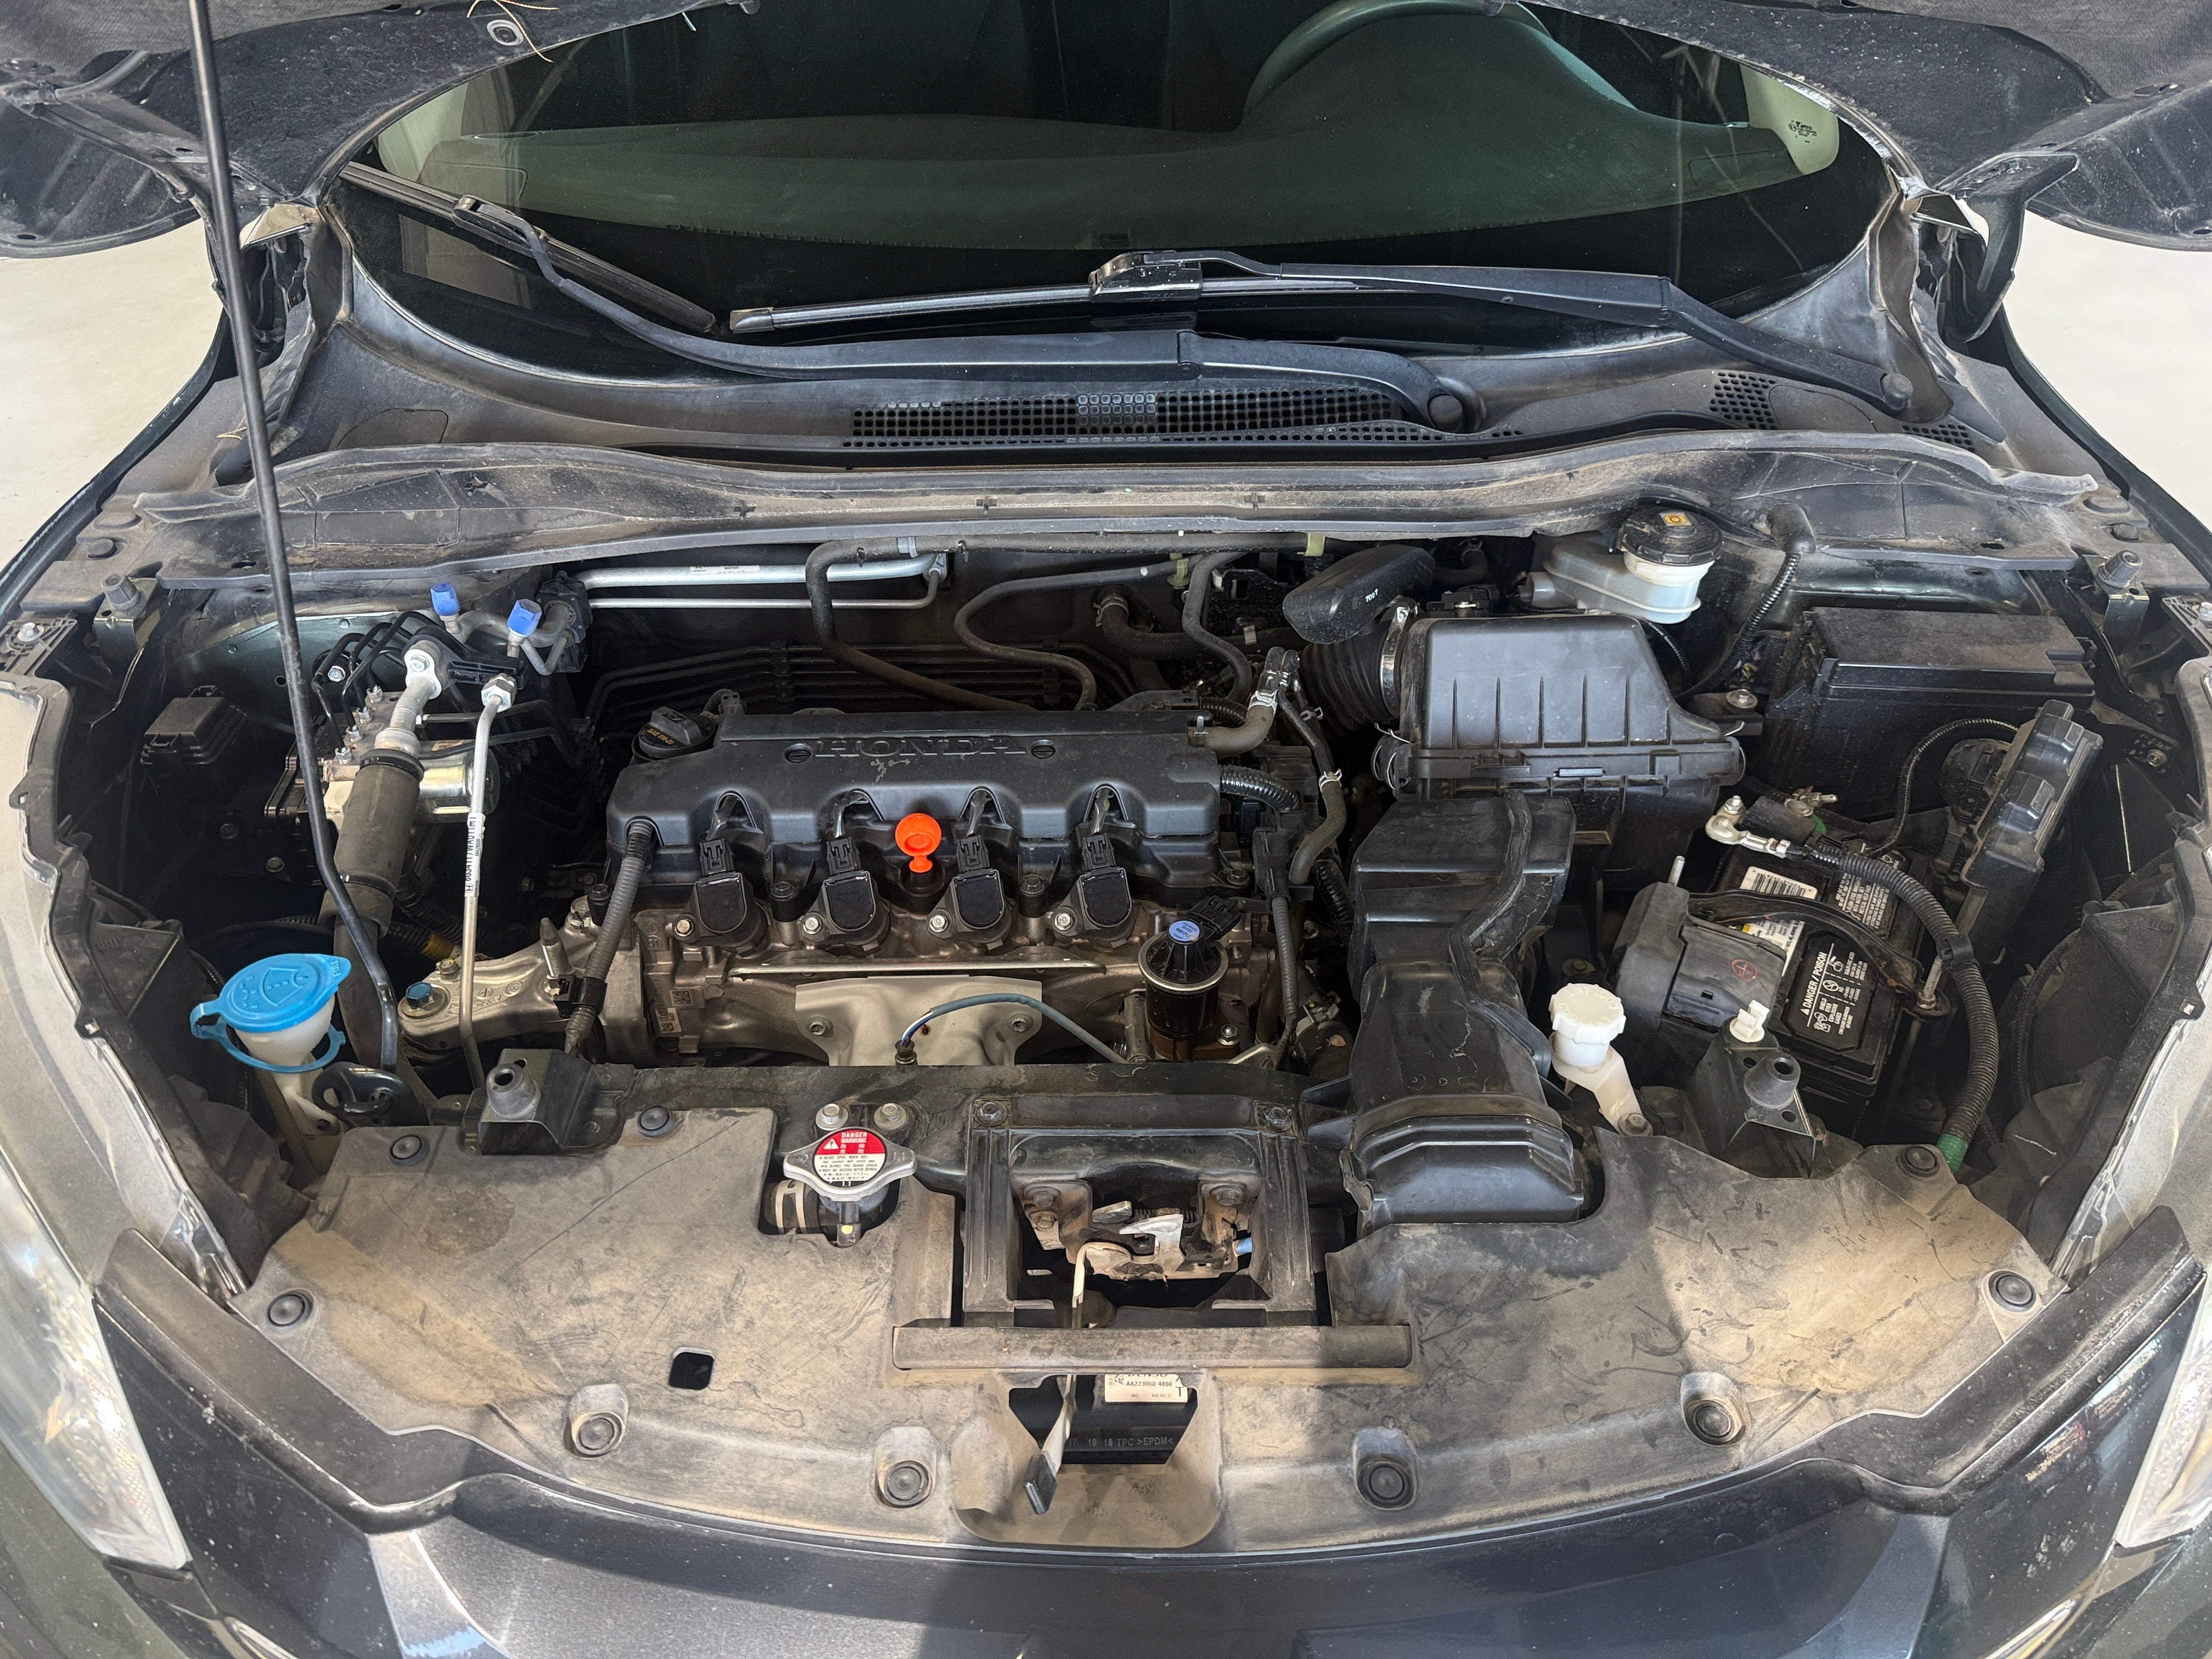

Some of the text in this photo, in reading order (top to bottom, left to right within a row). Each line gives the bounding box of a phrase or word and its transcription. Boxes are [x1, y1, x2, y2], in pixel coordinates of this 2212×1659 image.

[647, 729, 661, 737] SAE
[815, 739, 1026, 757] HONDA
[330, 961, 342, 977] PULL
[1803, 980, 1819, 1008] DANGER
[1812, 951, 1827, 977] POISON
[1087, 1438, 1097, 1447] 10
[1116, 1438, 1134, 1447] TPC
